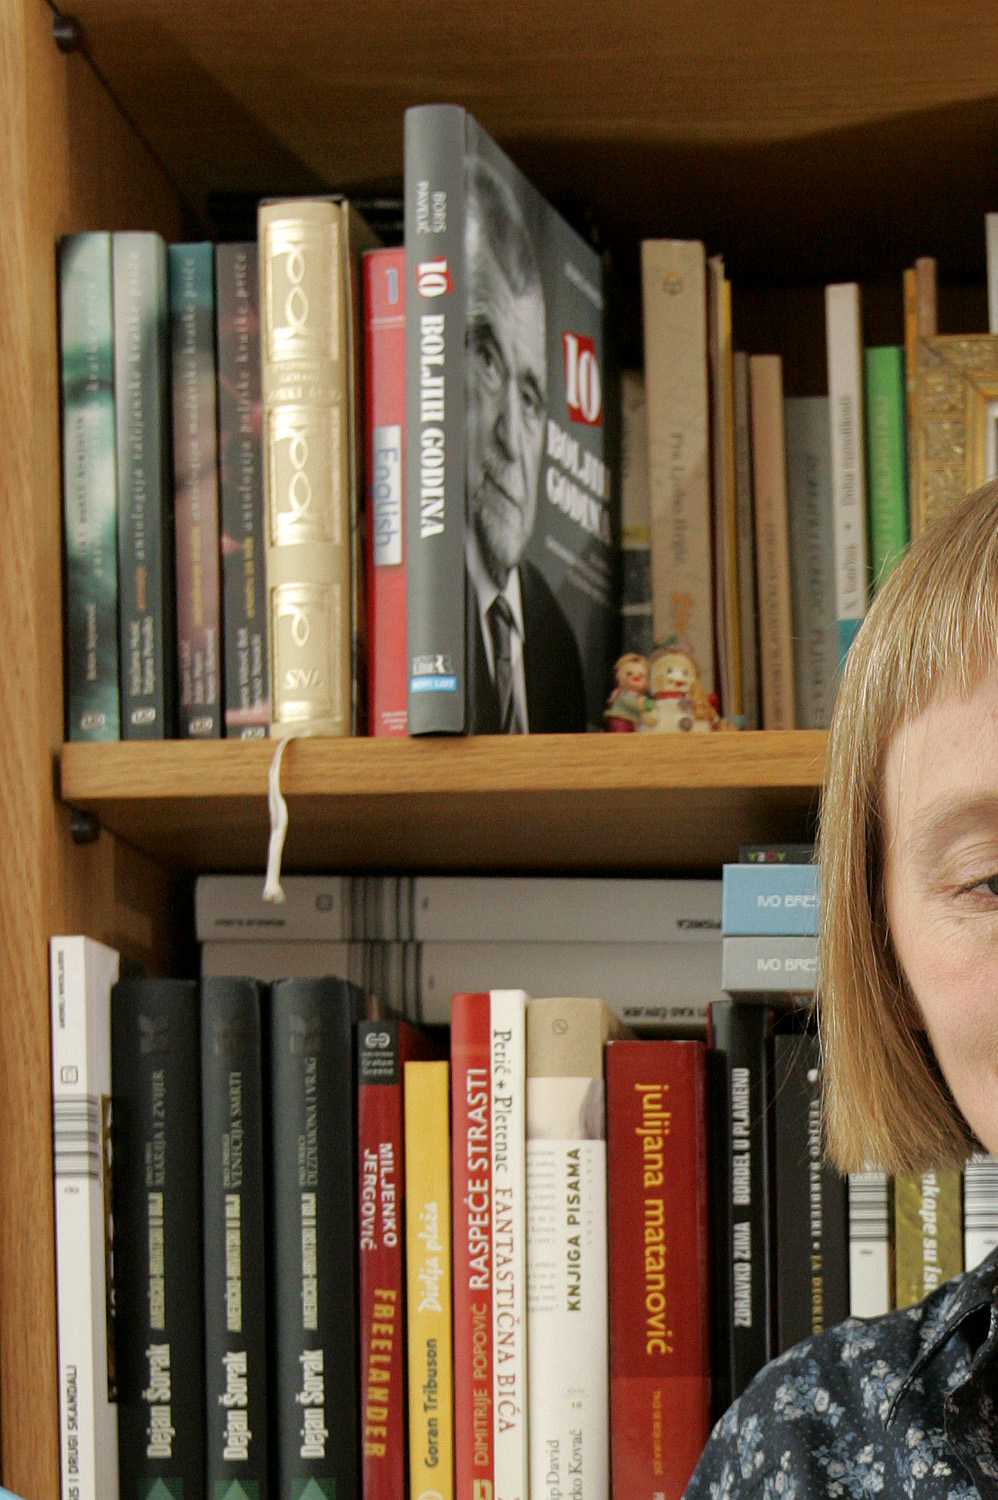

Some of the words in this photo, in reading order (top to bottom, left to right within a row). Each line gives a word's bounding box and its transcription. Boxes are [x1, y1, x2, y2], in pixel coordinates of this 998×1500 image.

[417, 258, 448, 299] 10
[420, 313, 446, 423] BOLJIH
[563, 333, 601, 423] 10
[370, 446, 400, 548] English
[420, 427, 446, 539] GODINA
[492, 1027, 513, 1074] Perić
[466, 1066, 489, 1171] STRASTI
[493, 1095, 513, 1172] Pletenac
[634, 1081, 674, 1188] julijana
[730, 1067, 750, 1136] PLAMENU
[731, 1137, 750, 1149] U
[732, 1151, 751, 1205] BORDEL
[359, 1147, 379, 1251] JERGOVIĆ
[379, 1141, 399, 1248] MILJENKO
[566, 1147, 582, 1226] PISAMA
[809, 1161, 822, 1237] BARBIERI
[466, 1176, 491, 1290] RASPEĆE
[732, 1221, 751, 1257] ZIMA
[493, 1185, 520, 1364] FANTASTIČNA
[566, 1234, 582, 1311] KNJIGA
[644, 1197, 674, 1355] matanović
[732, 1259, 752, 1328] ZDRAVKO
[142, 1343, 171, 1403] Šorak
[296, 1348, 324, 1405] Šorak
[363, 1287, 397, 1458] FREELANDER
[424, 1337, 442, 1412] Tribuson
[470, 1301, 489, 1378] POPOVIĆ
[219, 1351, 248, 1407] Šorak
[495, 1372, 519, 1433] BIĆA
[145, 1405, 174, 1460] Dejan
[223, 1410, 250, 1462] Dejan
[299, 1407, 327, 1459] Dejan
[424, 1417, 440, 1468] Goran
[472, 1387, 490, 1465] DIMITRIJE
[545, 1438, 565, 1487] David
[568, 1427, 585, 1474] Kovač
